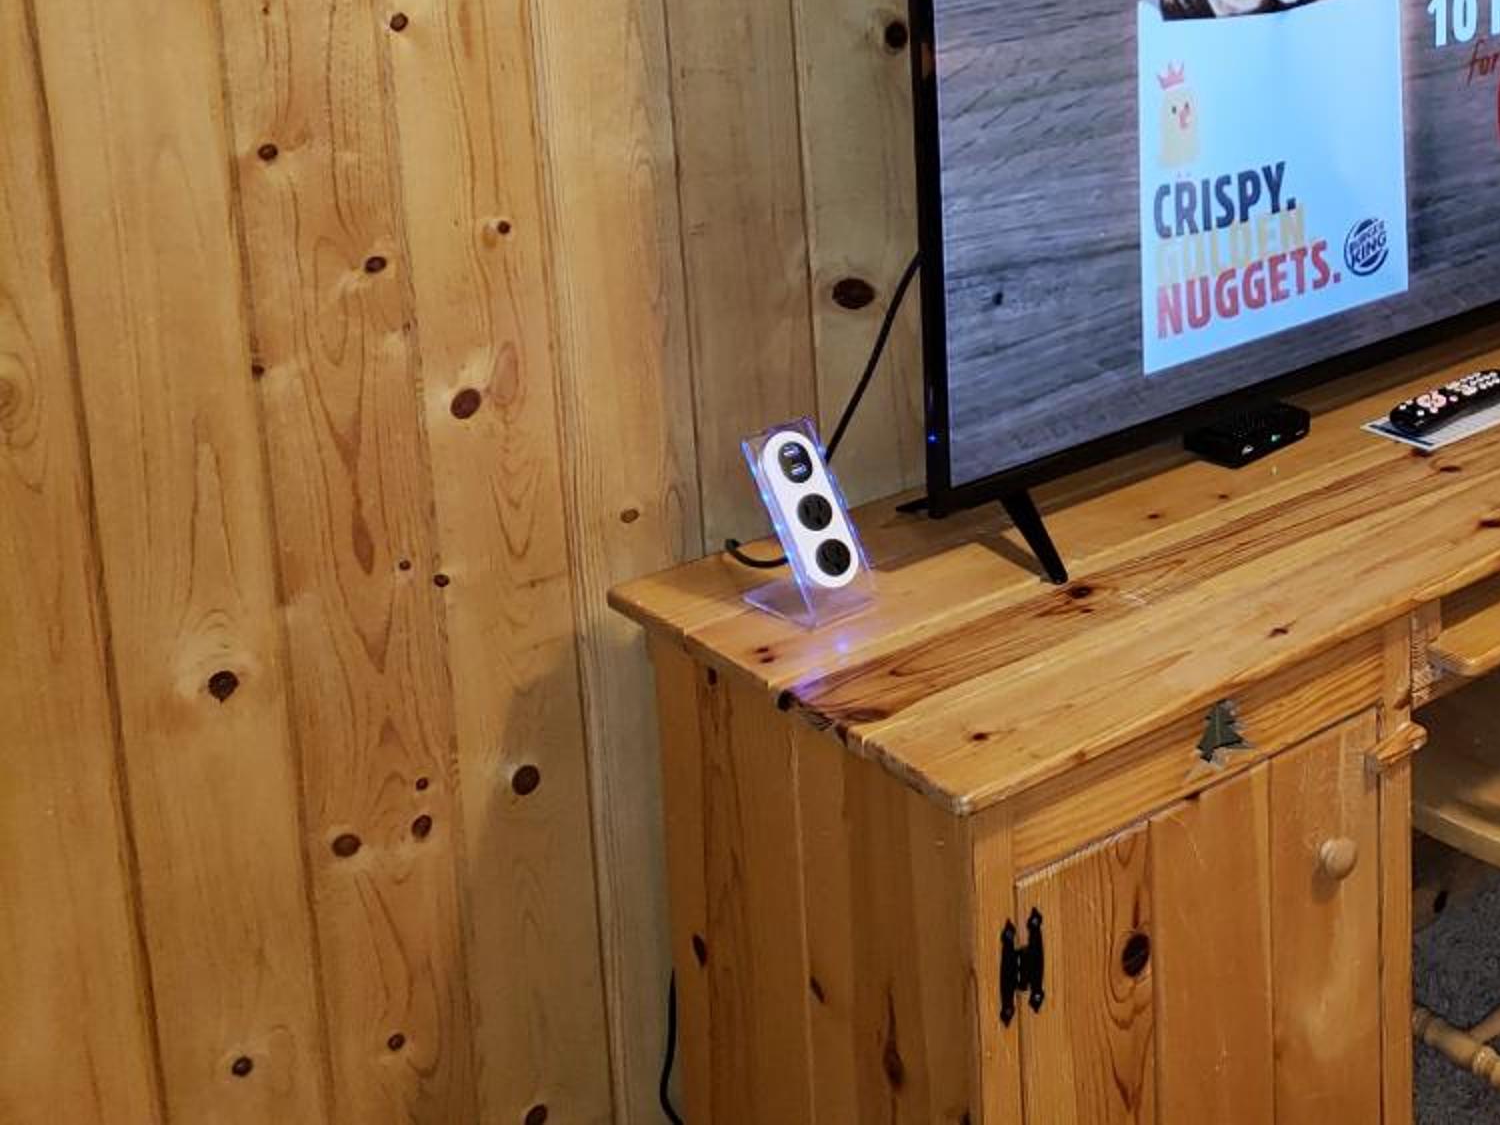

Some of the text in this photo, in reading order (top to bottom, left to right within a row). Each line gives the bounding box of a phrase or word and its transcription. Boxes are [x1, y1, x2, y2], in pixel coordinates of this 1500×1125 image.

[1153, 161, 1297, 239] CRISPY.
[1351, 230, 1387, 268] KING
[1157, 240, 1342, 340] NUGGETS.
